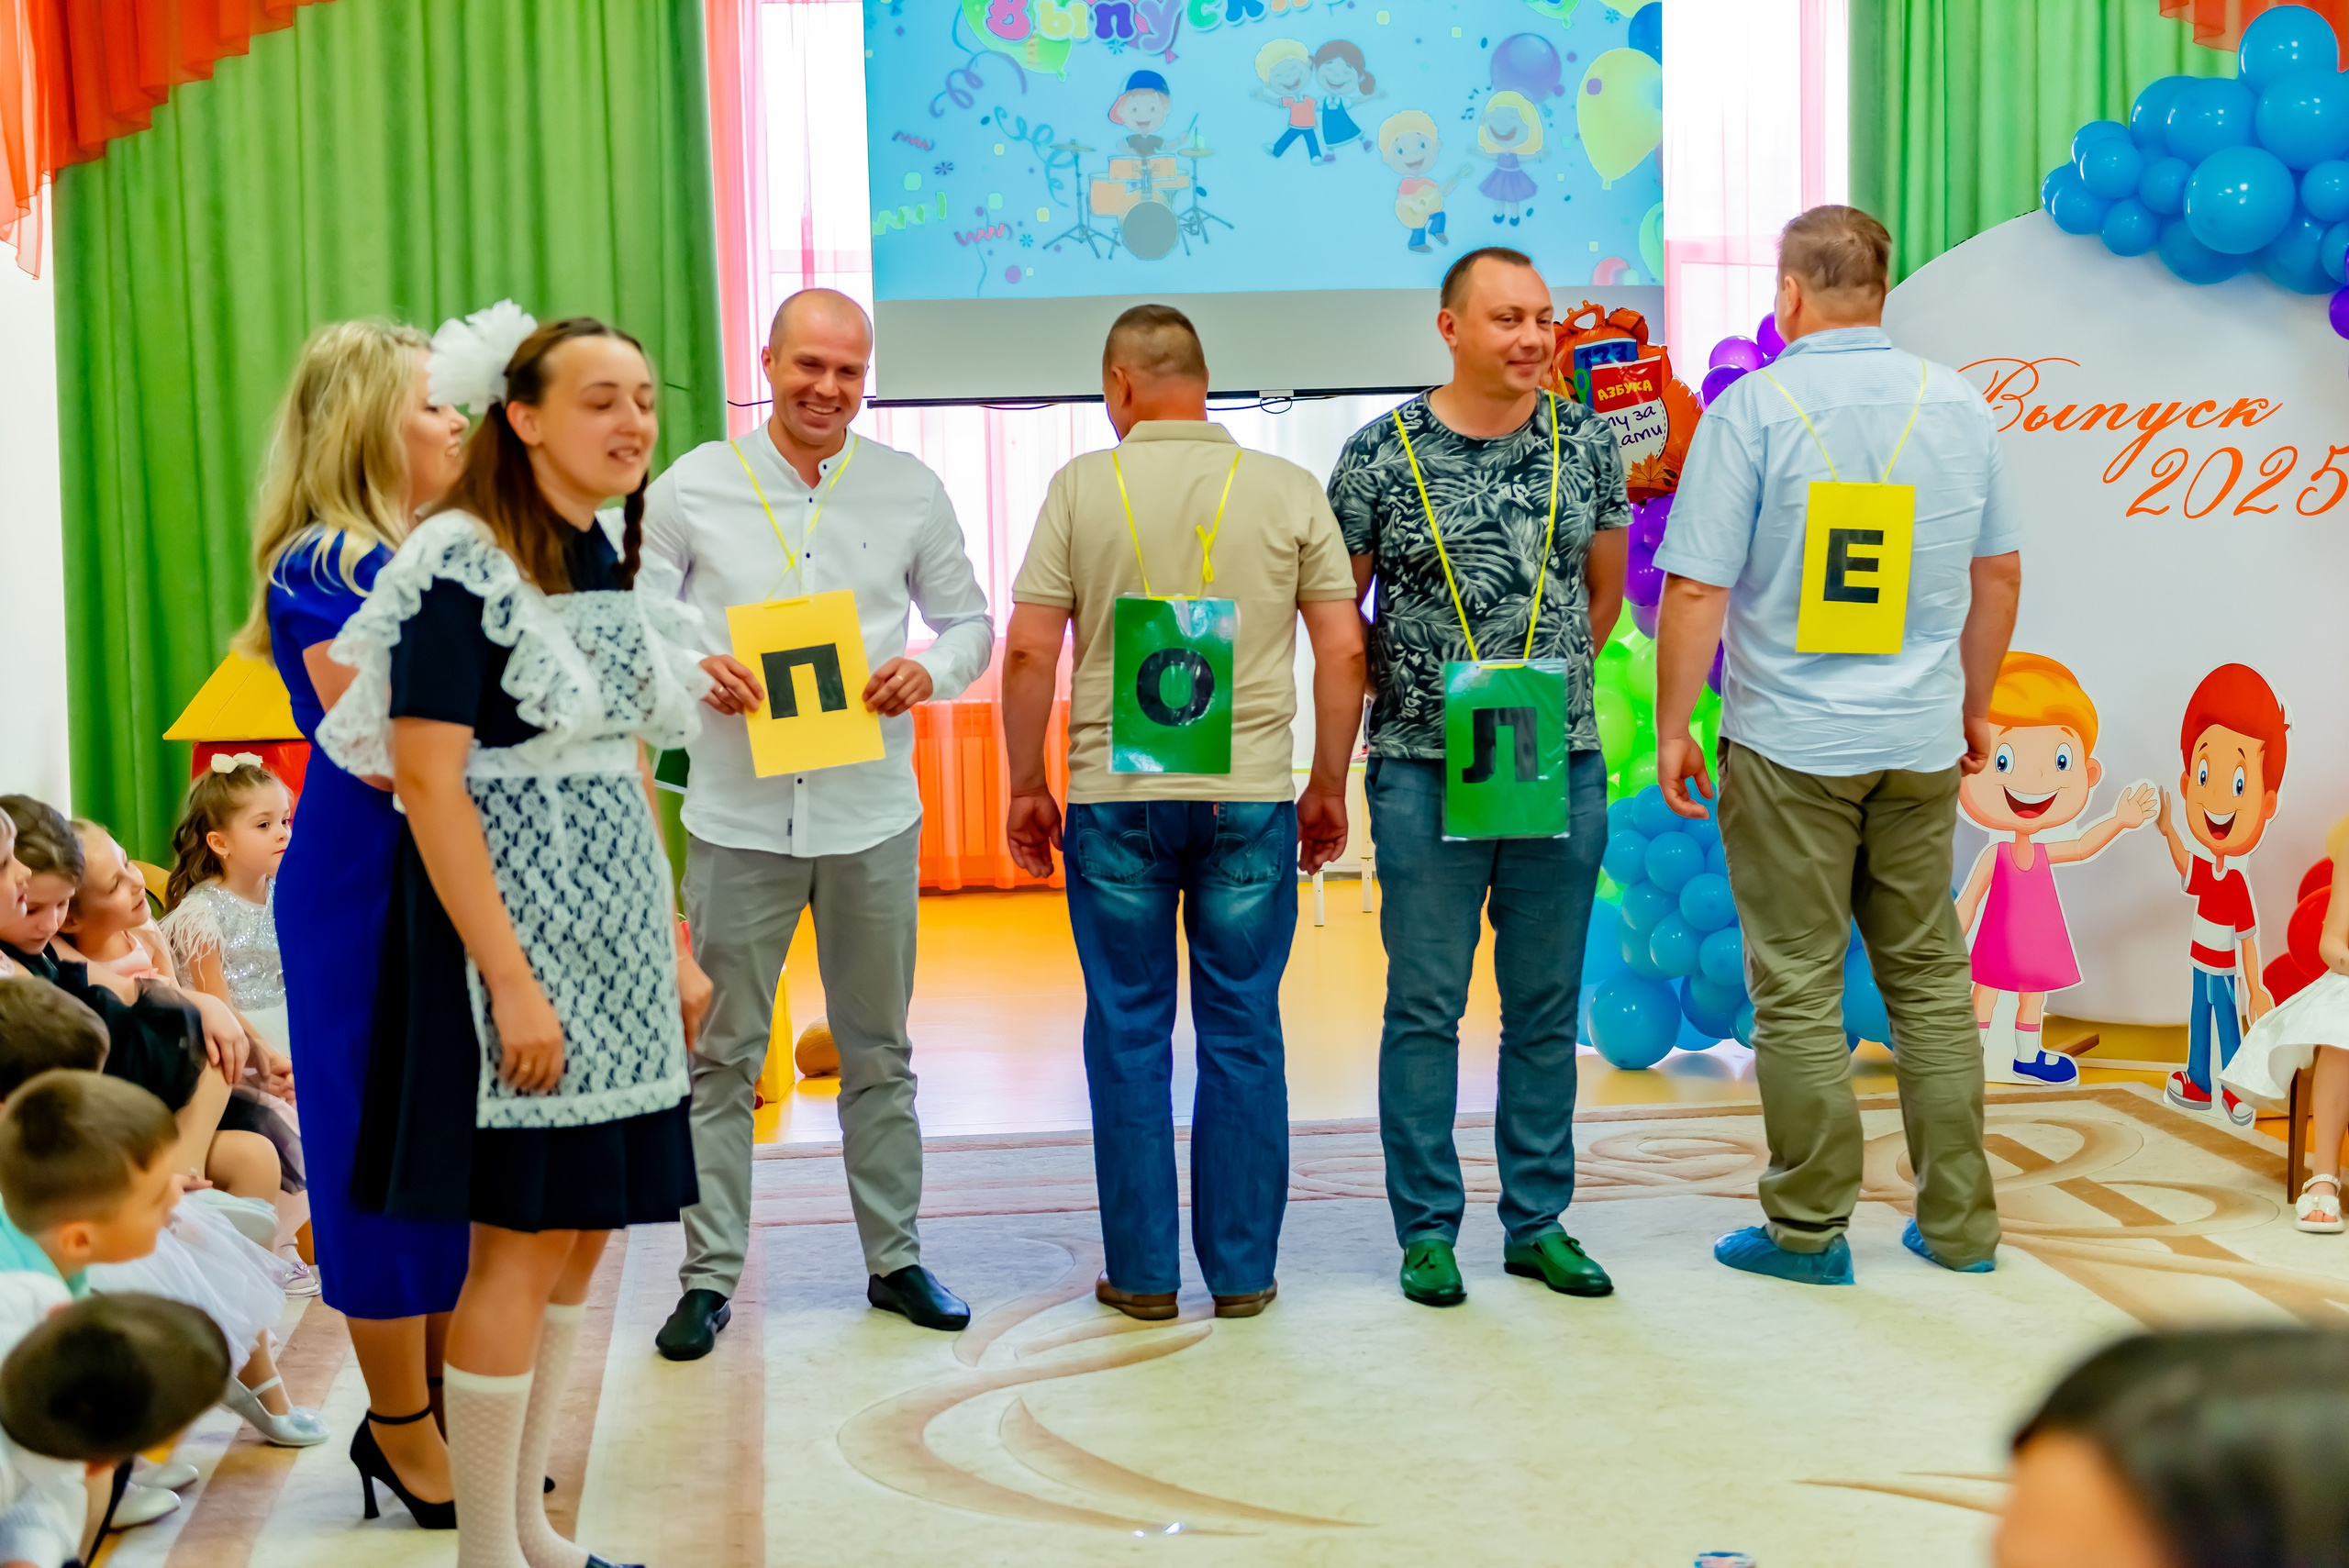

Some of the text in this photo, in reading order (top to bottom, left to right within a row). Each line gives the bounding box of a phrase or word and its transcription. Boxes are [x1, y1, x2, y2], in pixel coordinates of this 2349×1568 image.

[985, 0, 1309, 52] Выпус
[1579, 342, 1628, 369] 123
[1597, 379, 1653, 401] АЗБУКА
[1608, 406, 1656, 431] лу за
[1620, 425, 1663, 448] ами
[1957, 357, 2284, 484] Выпуск
[2126, 445, 2349, 519] 2025
[1822, 528, 1885, 604] Е
[761, 642, 848, 719] П
[1136, 647, 1215, 727] О
[1462, 706, 1539, 784] Л
